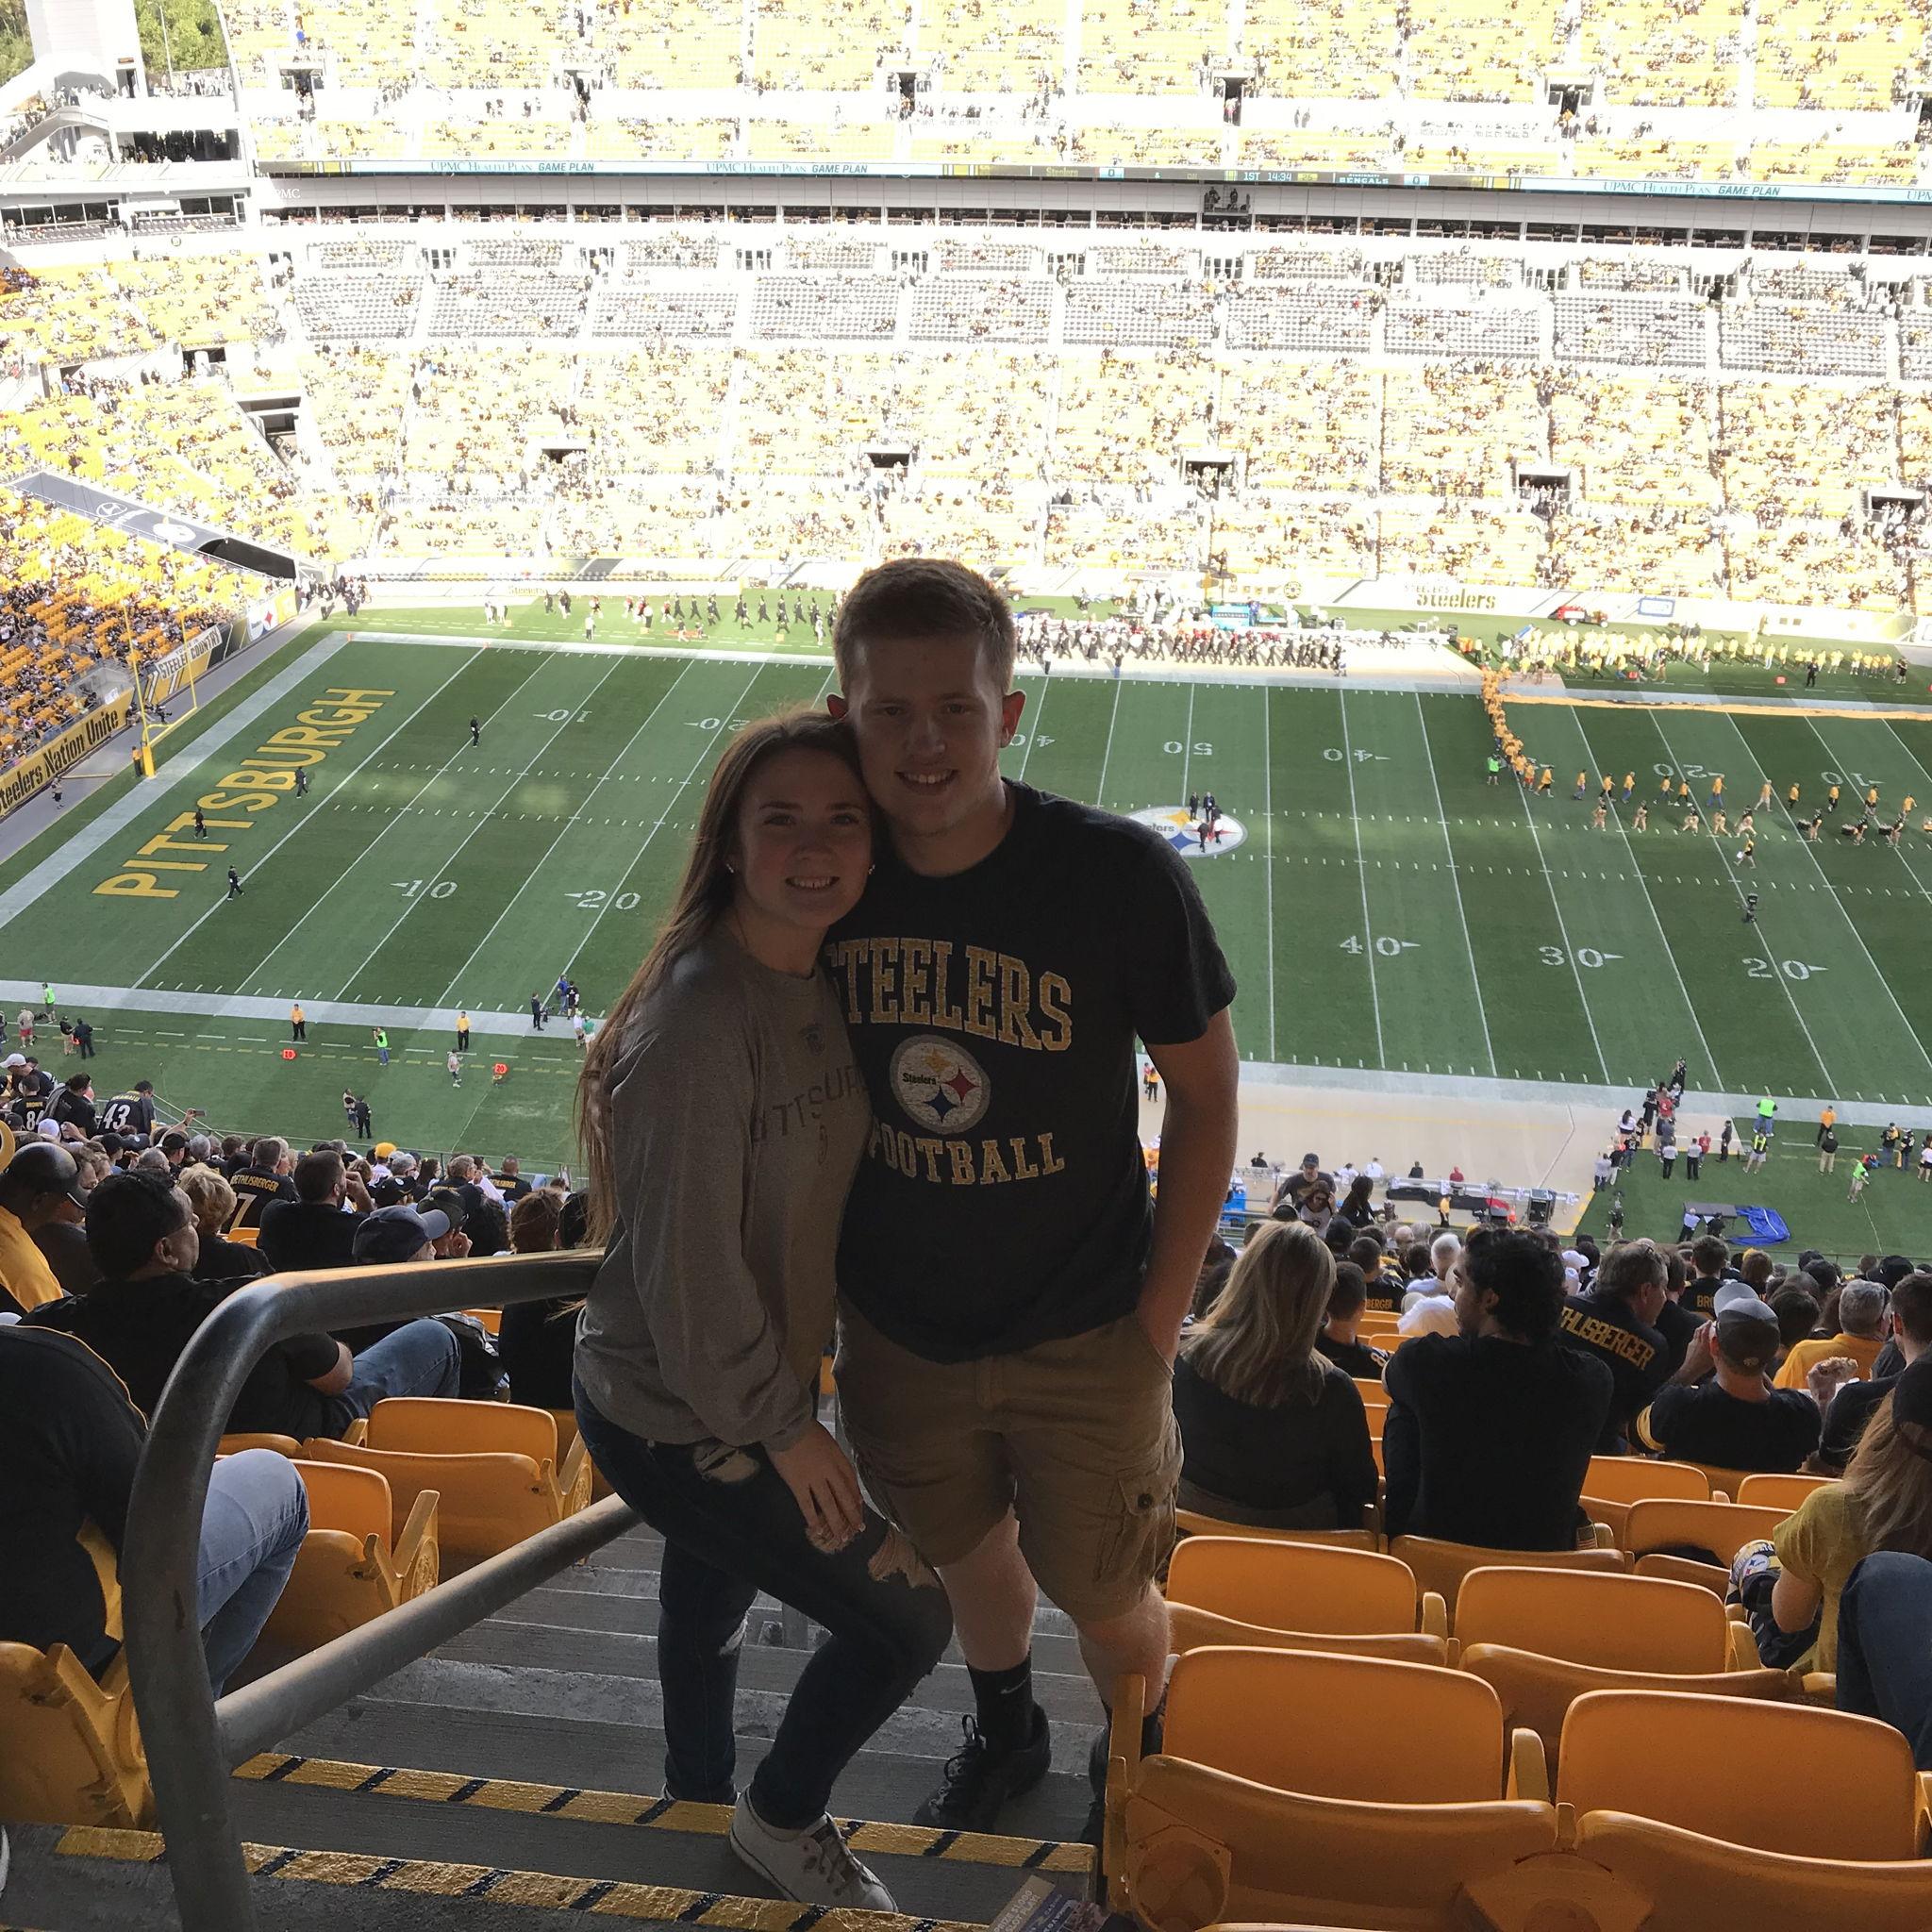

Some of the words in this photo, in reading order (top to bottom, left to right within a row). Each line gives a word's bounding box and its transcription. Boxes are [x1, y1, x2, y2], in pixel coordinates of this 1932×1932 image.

[431, 161, 465, 171] UPMC
[539, 162, 566, 171] GAME
[569, 162, 594, 171] PLAN
[707, 162, 741, 173] UPMC
[811, 164, 841, 174] GAME
[842, 164, 868, 174] PLAN
[1243, 172, 1260, 180] 1ST
[1267, 173, 1291, 182] 14:34
[1339, 176, 1389, 185] BENGALS
[1604, 181, 1641, 192] UPMC
[1718, 185, 1749, 195] GAME
[1751, 186, 1780, 196] PLAN
[1416, 588, 1496, 608] Steelers
[158, 652, 189, 679] STEELE
[0, 765, 43, 813] teelers
[42, 734, 85, 778] Nation
[86, 710, 120, 745] Unite
[92, 688, 398, 897] PITTSBURGH
[401, 879, 458, 899] 10
[576, 890, 641, 910] 20
[1339, 935, 1404, 957] 40
[1538, 945, 1606, 968] 30
[1741, 958, 1811, 981] 20
[902, 1071, 938, 1086] Steelers
[103, 1103, 131, 1130] 43
[230, 1192, 258, 1228] 7
